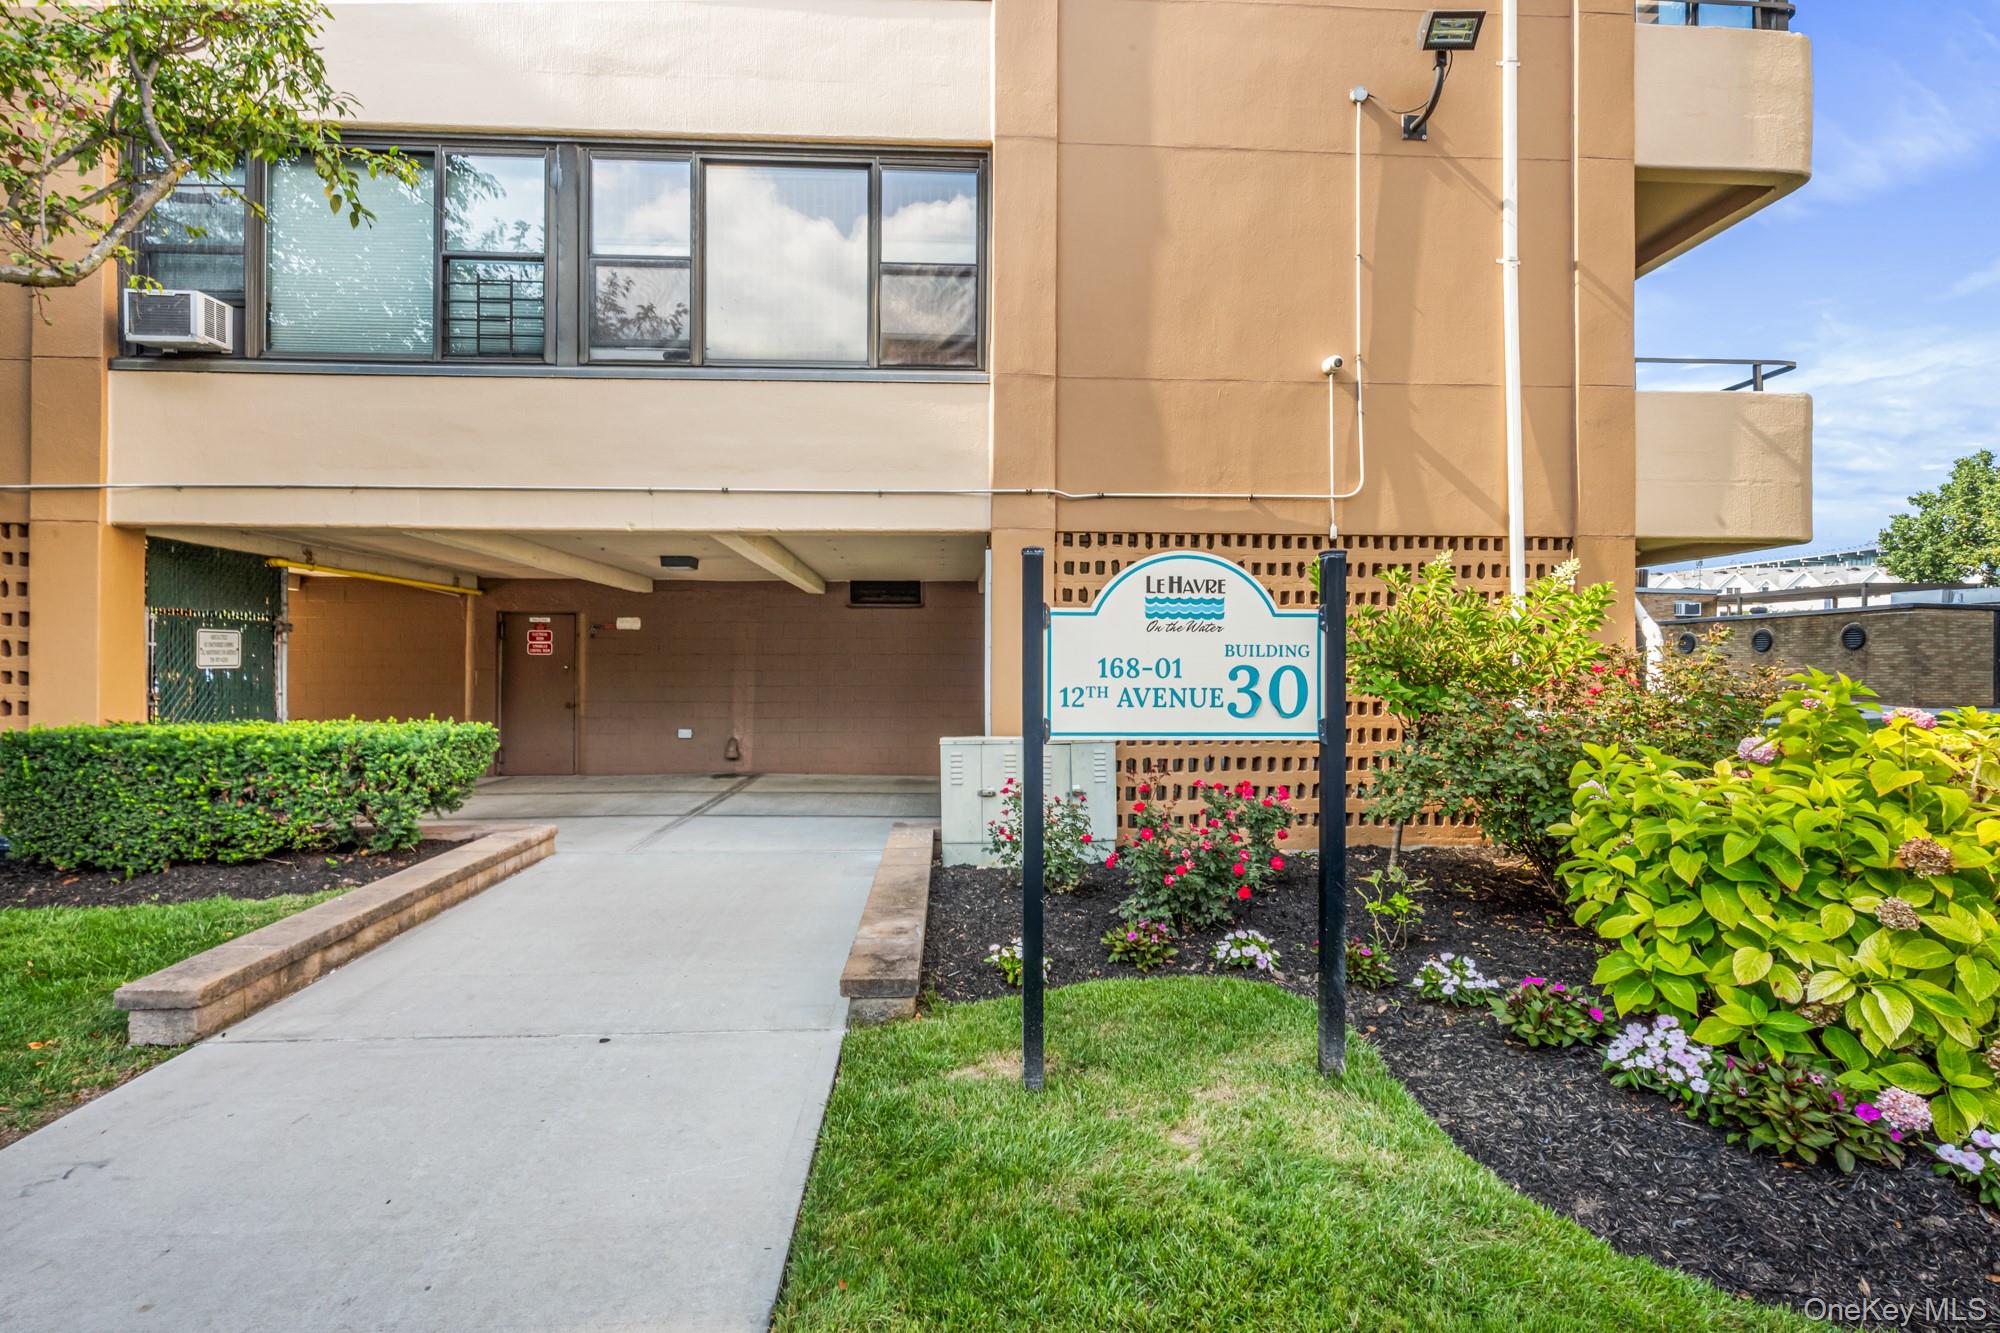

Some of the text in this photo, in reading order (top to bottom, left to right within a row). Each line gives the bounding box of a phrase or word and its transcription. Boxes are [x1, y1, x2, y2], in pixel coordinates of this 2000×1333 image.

[1146, 620, 1224, 632] On the Water
[1224, 644, 1311, 658] BUILDING
[1097, 657, 1183, 679] 168-01
[1059, 685, 1225, 708] 12TH AVENUE
[1227, 664, 1309, 719] 30
